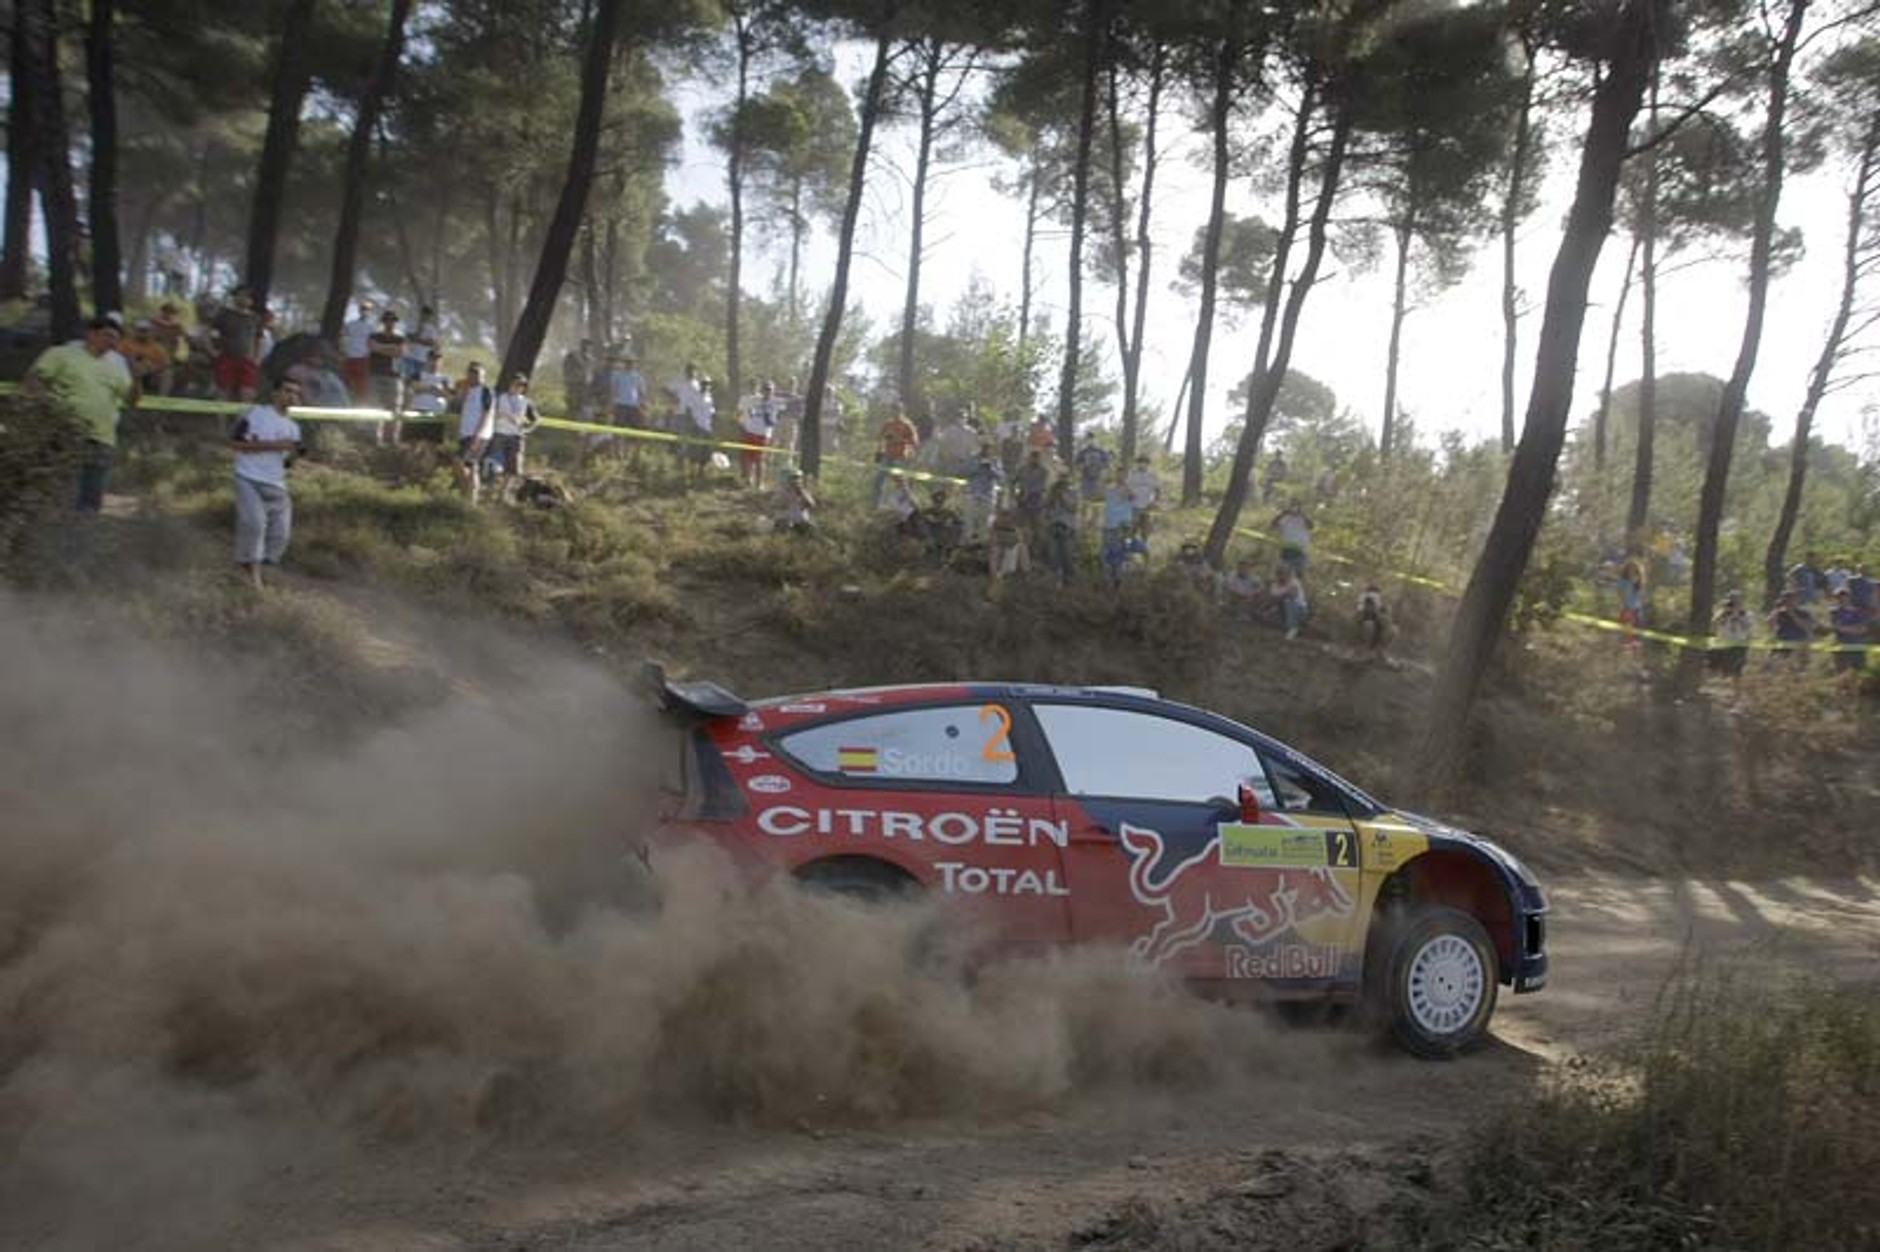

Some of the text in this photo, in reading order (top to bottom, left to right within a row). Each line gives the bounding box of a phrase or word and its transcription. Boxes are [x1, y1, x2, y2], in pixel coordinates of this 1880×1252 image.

[978, 703, 1016, 762] 2
[884, 748, 971, 774] Sordo
[758, 806, 1069, 847] CITROËN
[1335, 833, 1348, 866] 2
[935, 863, 1070, 896] TOTAL
[1226, 944, 1336, 978] Red Bull
